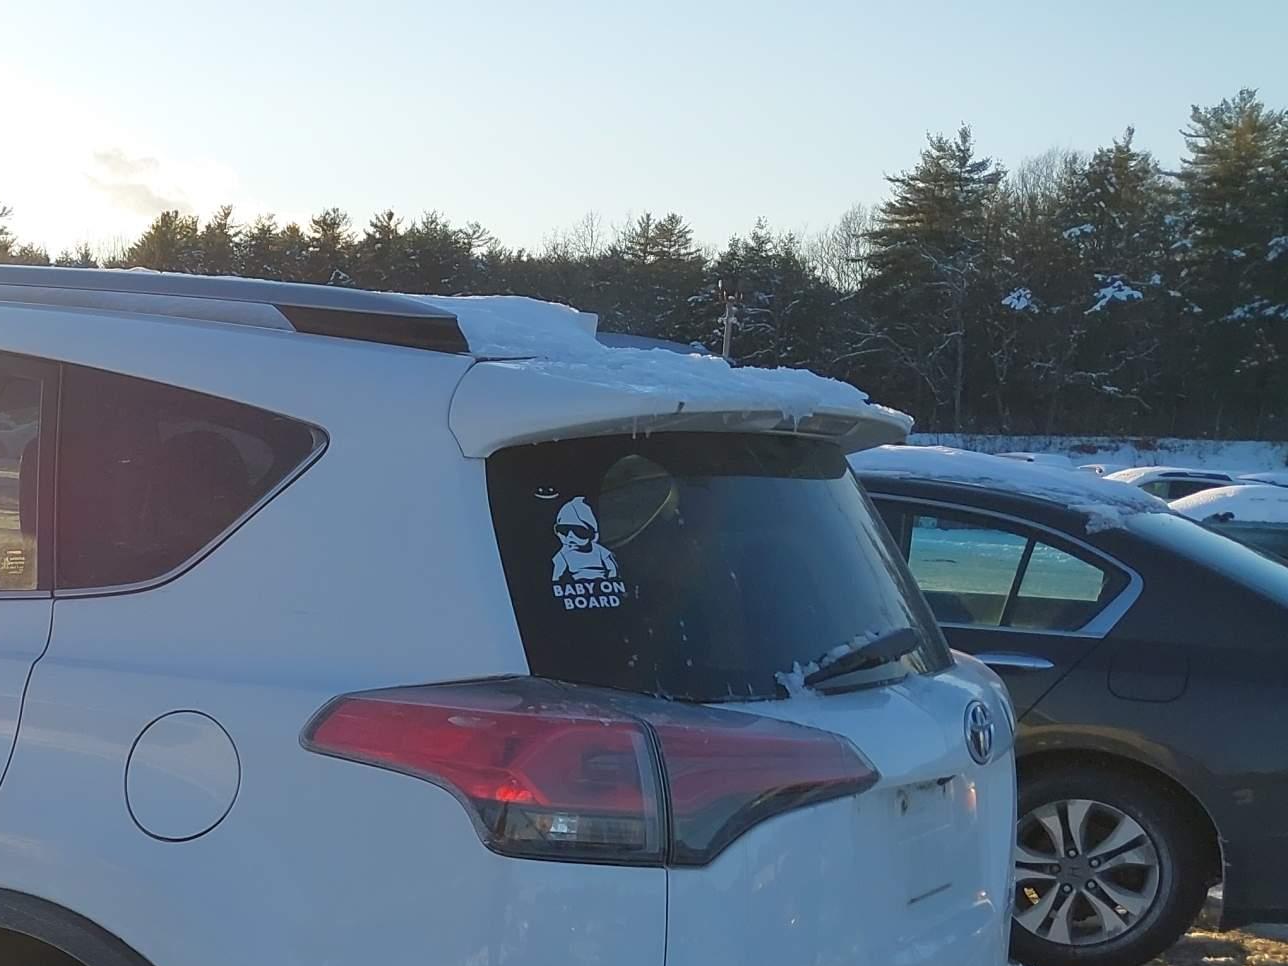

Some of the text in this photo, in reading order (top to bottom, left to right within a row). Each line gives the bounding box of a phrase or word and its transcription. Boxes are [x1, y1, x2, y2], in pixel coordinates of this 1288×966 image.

[553, 581, 626, 597] BABY ON
[563, 595, 620, 610] BOARD
